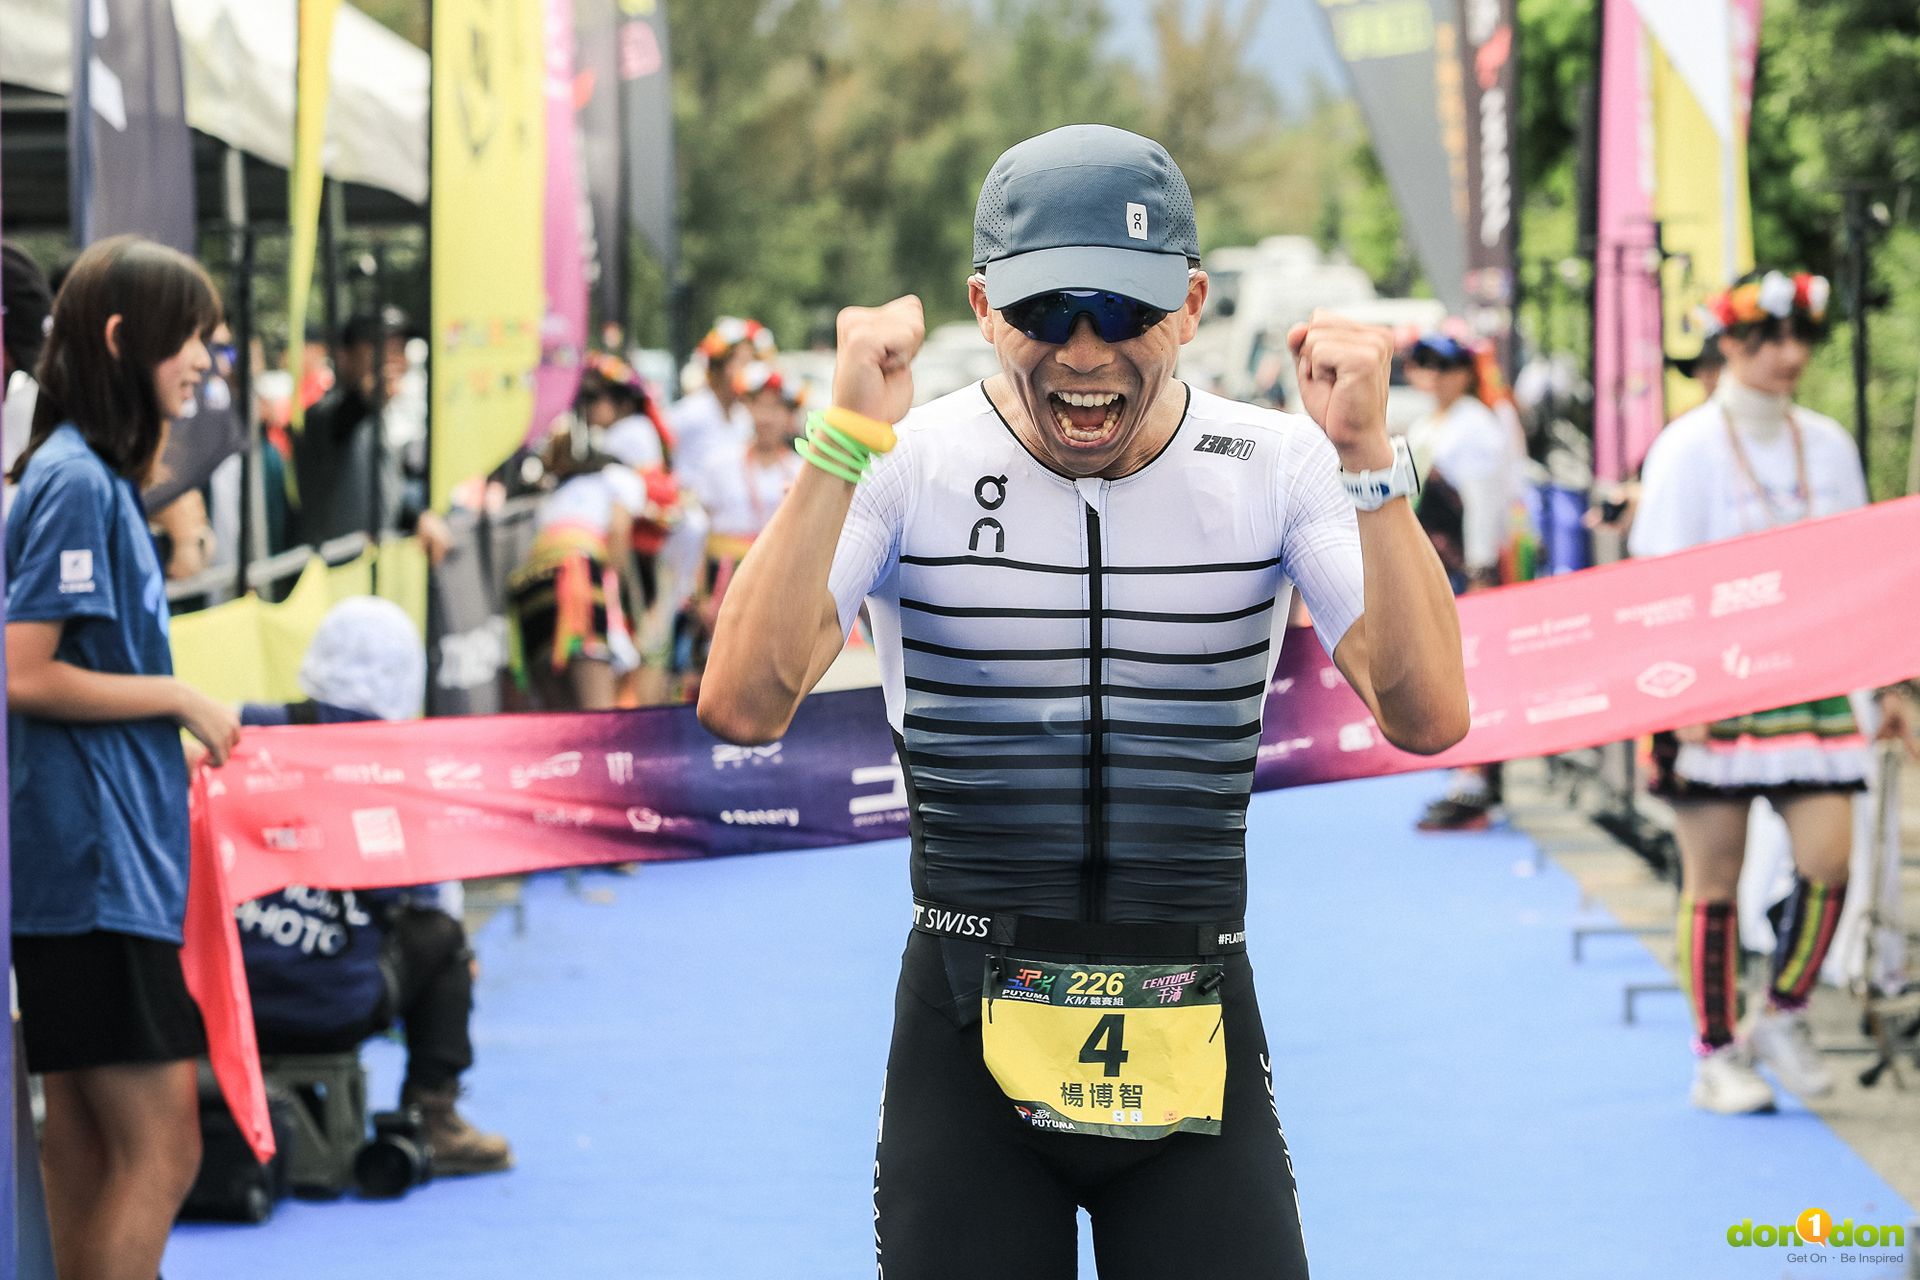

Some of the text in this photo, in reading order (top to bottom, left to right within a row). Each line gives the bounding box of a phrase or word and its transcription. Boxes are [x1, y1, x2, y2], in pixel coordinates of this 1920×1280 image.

[925, 908, 991, 938] SWISS
[1066, 971, 1126, 996] 226
[1142, 970, 1198, 990] CENTUPLE
[1001, 989, 1050, 1001] PUYUMA
[1064, 996, 1124, 1006] KM 競賽組
[1078, 1013, 1129, 1078] 4
[1060, 1082, 1143, 1109] 楊博智
[1031, 1119, 1076, 1130] PUYUMA
